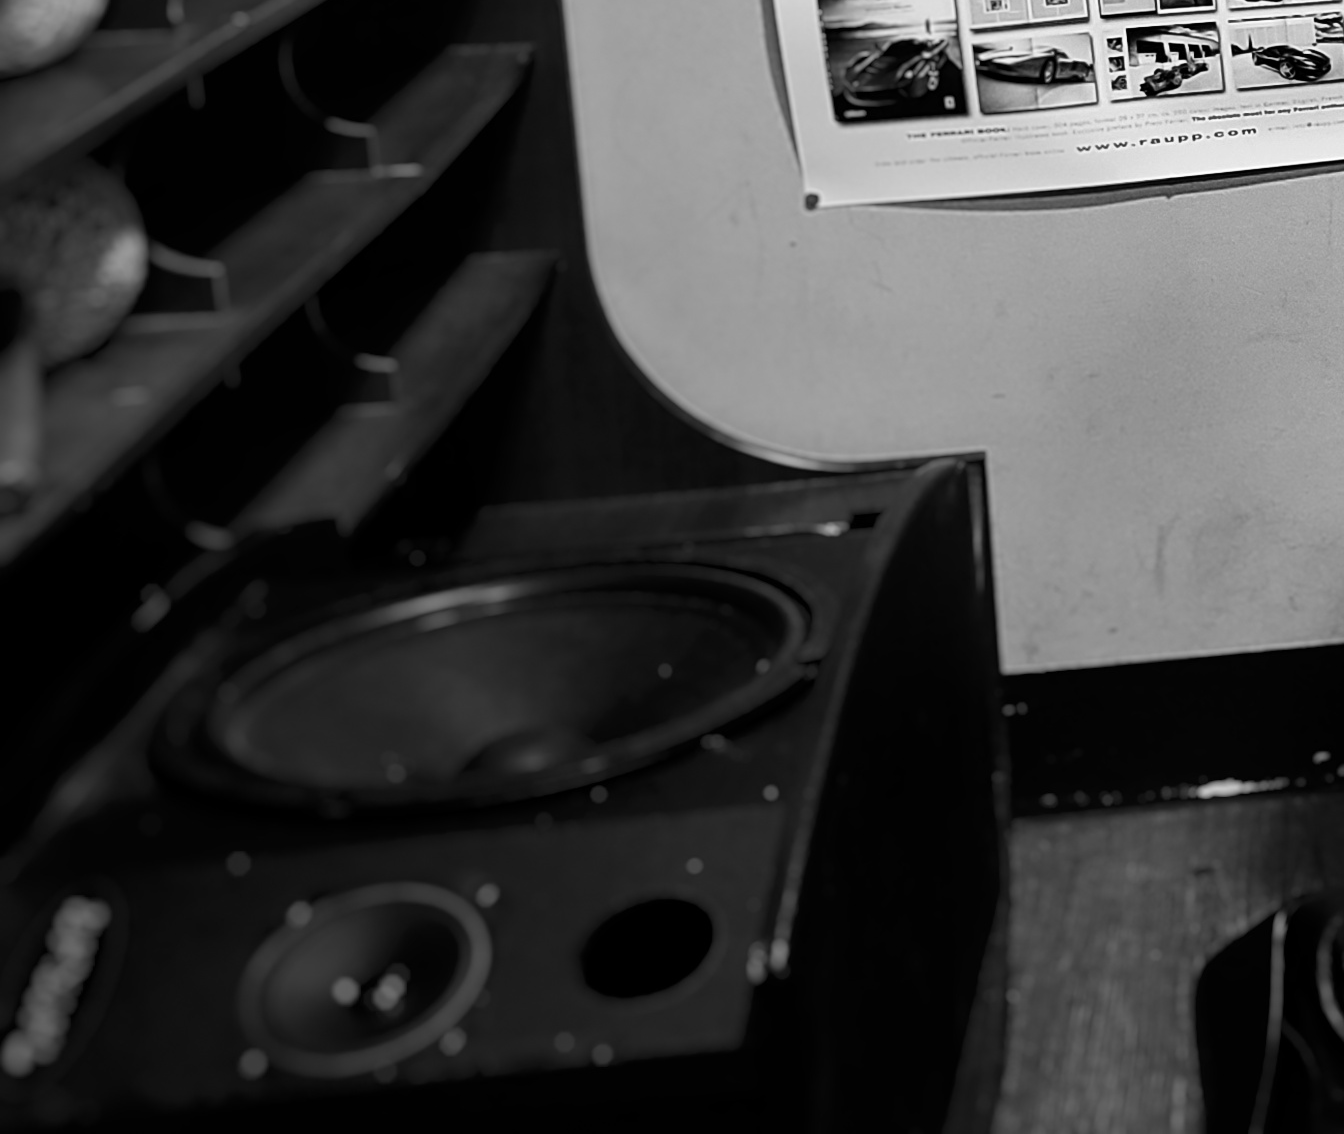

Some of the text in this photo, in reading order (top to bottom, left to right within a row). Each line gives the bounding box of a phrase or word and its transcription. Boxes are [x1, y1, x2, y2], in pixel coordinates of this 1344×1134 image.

[1292, 104, 1320, 113] Ferrari
[930, 128, 974, 138] FERRARI
[1075, 127, 1258, 153] www.raupp.com
